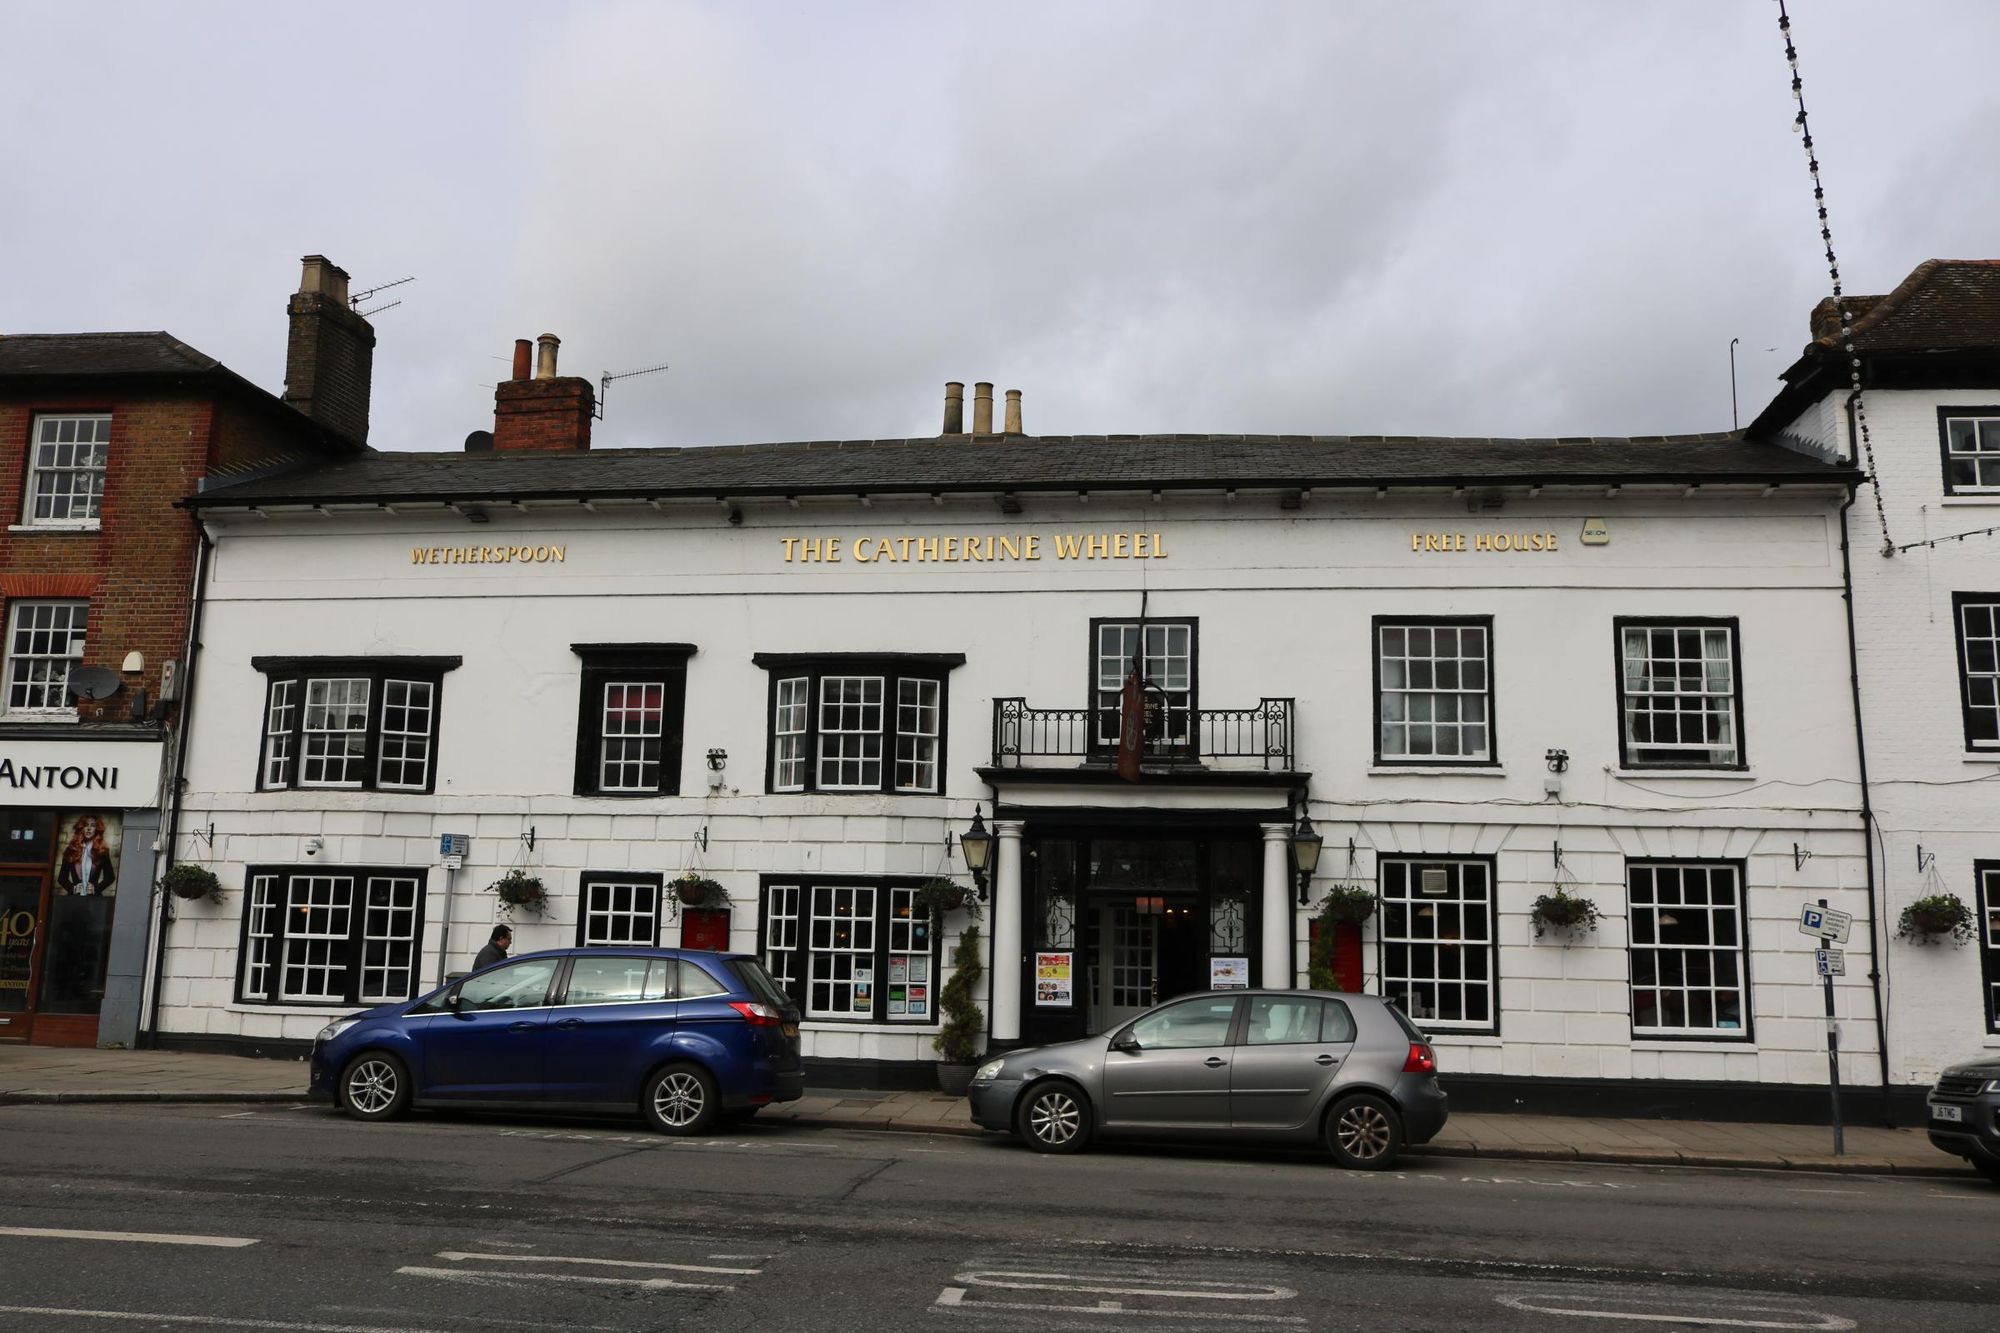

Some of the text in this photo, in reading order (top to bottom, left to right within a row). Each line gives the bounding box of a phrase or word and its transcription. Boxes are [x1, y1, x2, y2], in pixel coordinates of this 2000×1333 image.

[781, 533, 1168, 562] THE CATHERINE WHEEL
[1411, 533, 1558, 552] FREE HOUSE
[411, 545, 566, 564] WETHERSPOON
